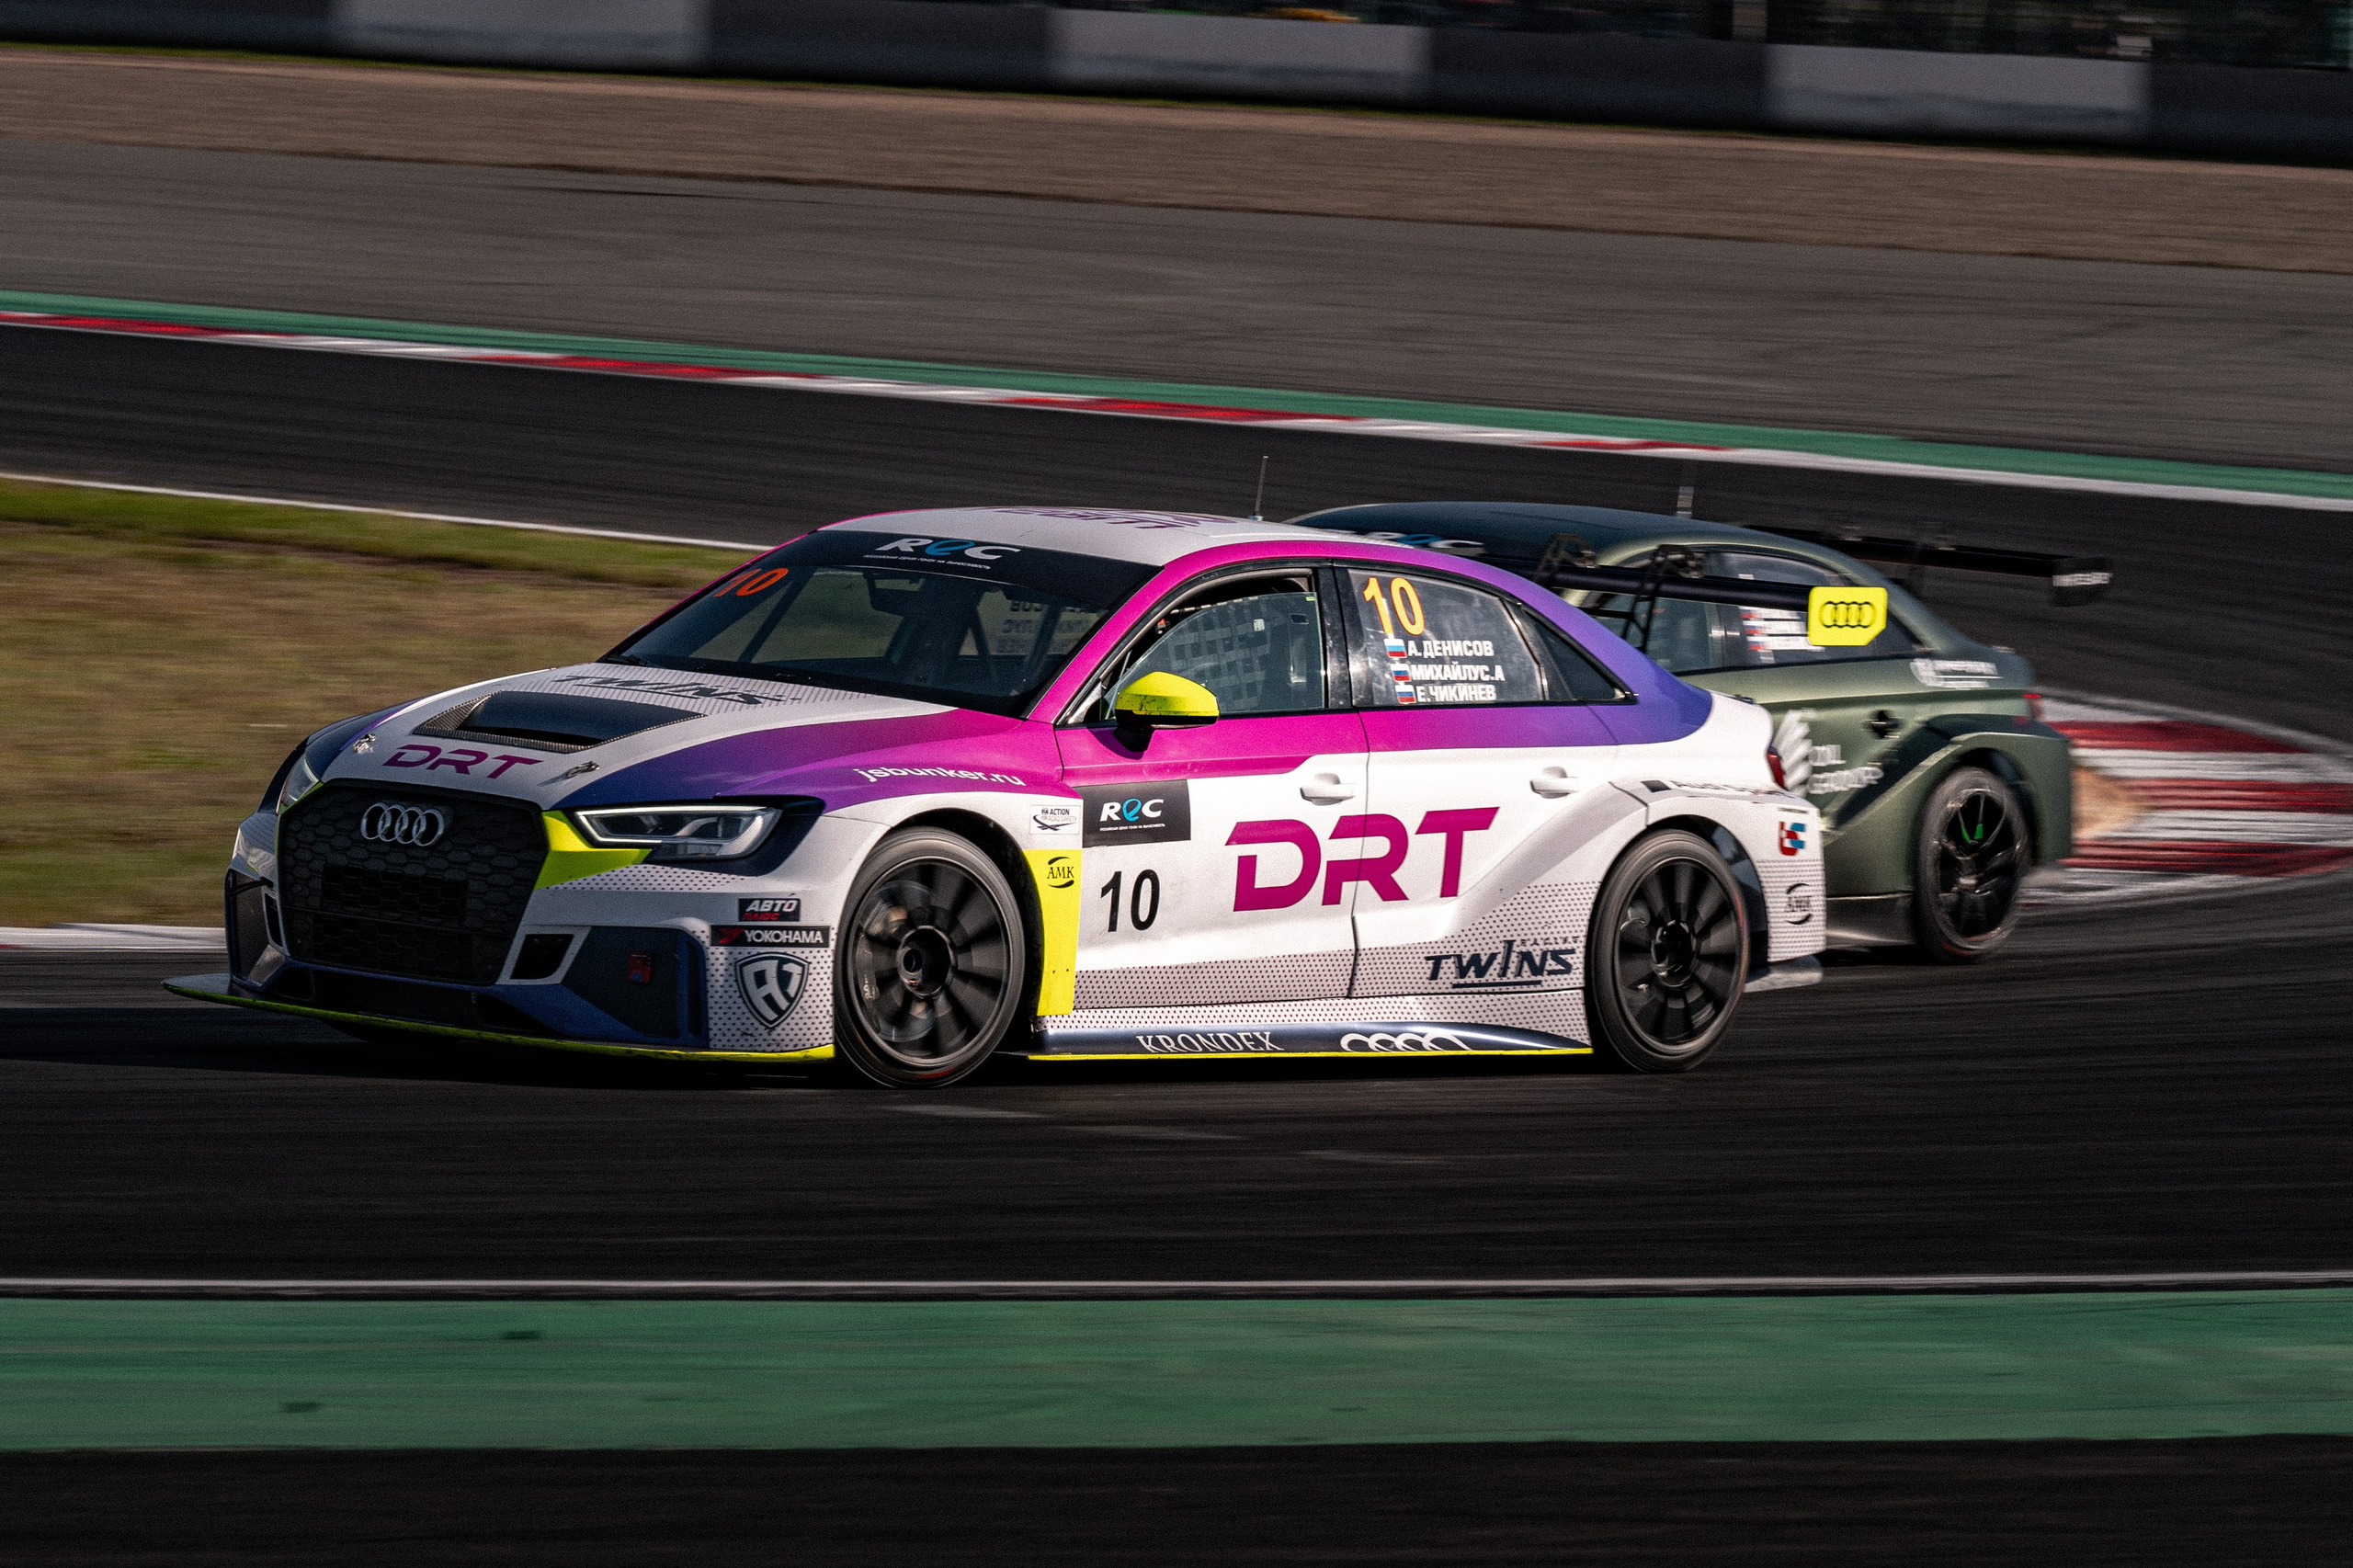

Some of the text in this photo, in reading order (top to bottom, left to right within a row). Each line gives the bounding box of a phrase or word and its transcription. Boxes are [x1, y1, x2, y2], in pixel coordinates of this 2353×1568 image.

[713, 567, 790, 597] 10
[1362, 576, 1426, 636] 10
[382, 744, 544, 779] DRT
[853, 767, 1026, 787] jsbunker.ru
[1050, 808, 1070, 816] ACTION
[1224, 806, 1501, 912] DRT
[1100, 869, 1161, 933] 10
[744, 929, 824, 944] YOKOHAMA
[1424, 939, 1576, 982] TWINS
[1135, 1031, 1286, 1053] KRONDEX
